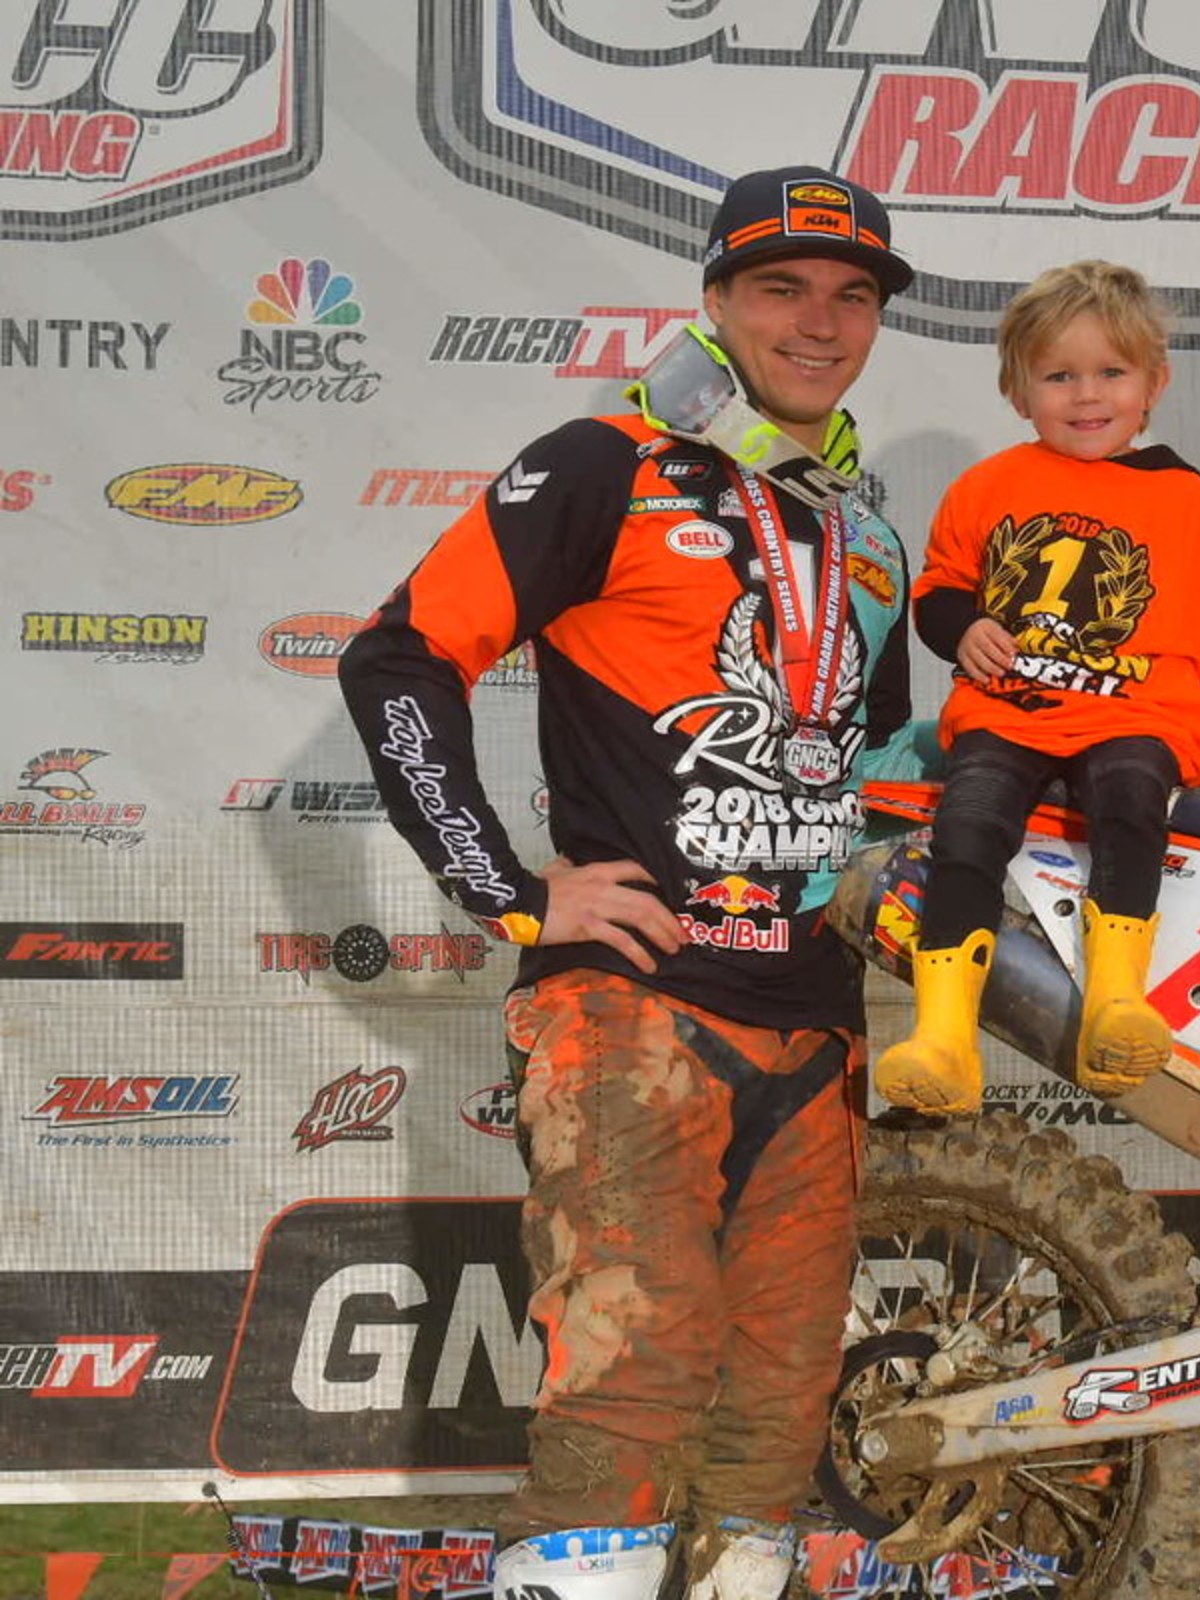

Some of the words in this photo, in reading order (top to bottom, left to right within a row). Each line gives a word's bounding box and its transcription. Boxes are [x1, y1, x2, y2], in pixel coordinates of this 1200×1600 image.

[804, 214, 840, 227] KTM
[240, 328, 367, 372] NBC
[217, 358, 382, 414] Sports
[108, 472, 301, 510] FMF
[678, 532, 724, 547] BELL
[1058, 515, 1101, 537] 2018
[756, 508, 787, 578] COUNTRY
[777, 579, 799, 632] SERIES
[1020, 537, 1086, 619] 1
[822, 565, 842, 627] NATIONAL
[23, 614, 206, 645] HINSON
[271, 631, 333, 658] Twin
[38, 801, 146, 826] BALLS
[680, 787, 791, 825] 2018
[5, 932, 173, 962] FANTIC
[676, 914, 734, 948] Red
[732, 917, 790, 952] Bull
[35, 1076, 236, 1122] AMSOIL
[982, 1085, 1032, 1100] OCKY
[37, 1133, 70, 1146] The
[72, 1133, 113, 1146] First
[137, 1134, 231, 1149] Synthetics
